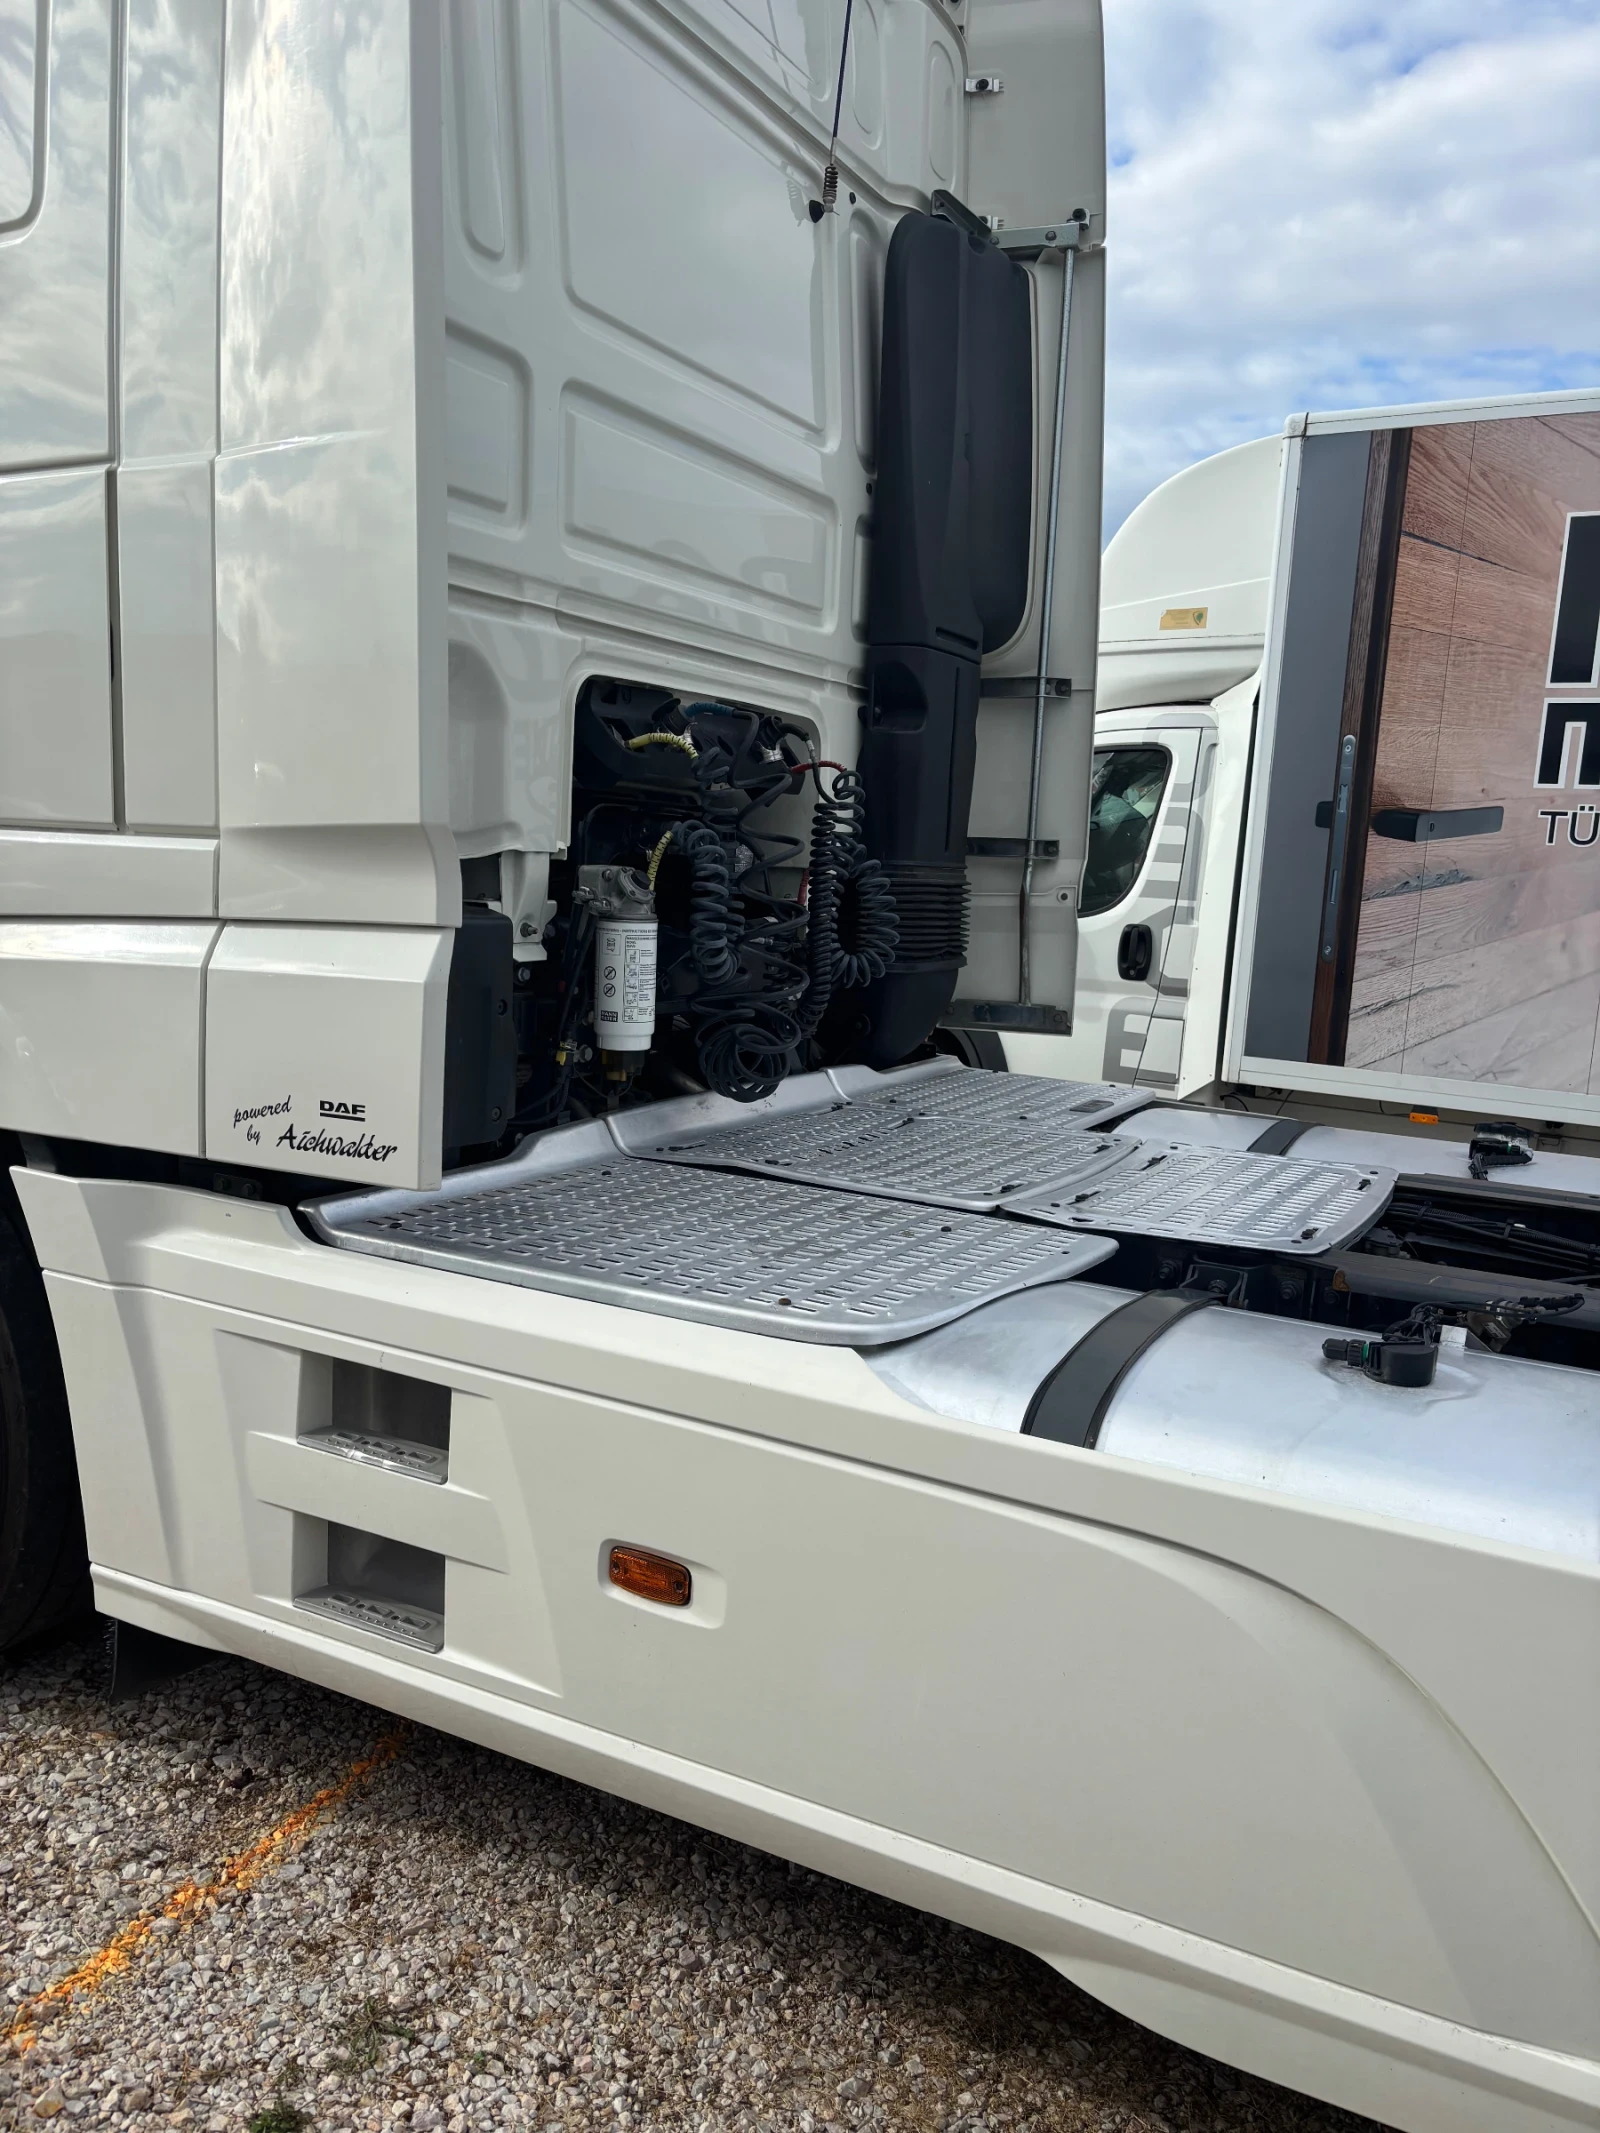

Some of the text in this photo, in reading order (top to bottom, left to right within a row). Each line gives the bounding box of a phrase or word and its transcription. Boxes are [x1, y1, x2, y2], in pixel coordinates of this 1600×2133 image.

[234, 1094, 292, 1129] powered
[319, 1100, 366, 1115] DAF
[246, 1123, 398, 1162] by Aichwalder
